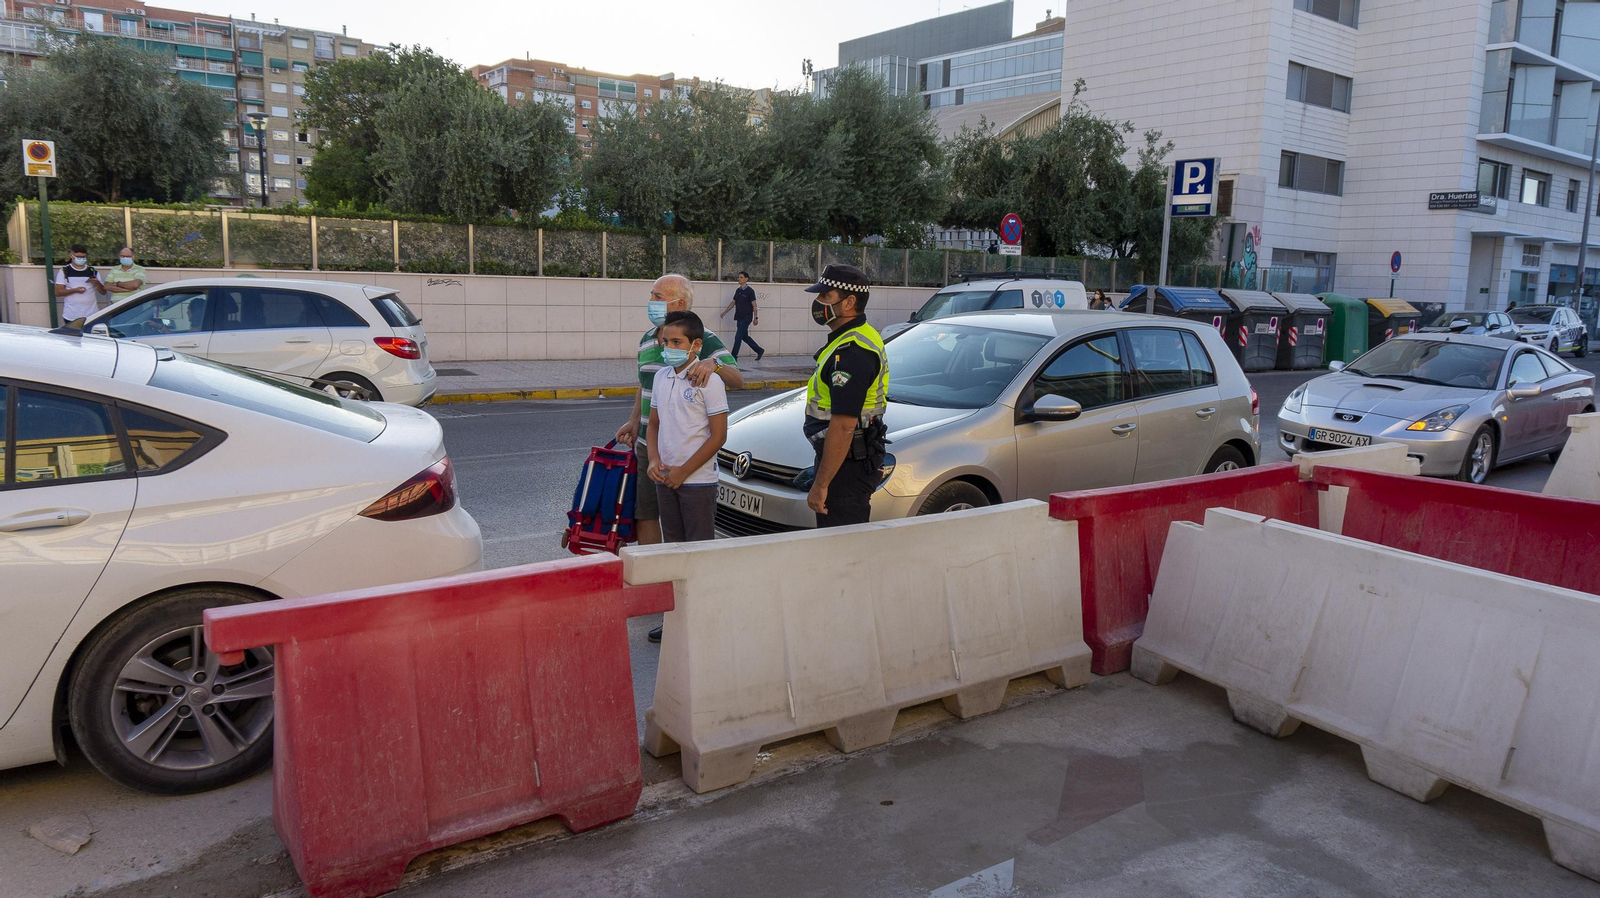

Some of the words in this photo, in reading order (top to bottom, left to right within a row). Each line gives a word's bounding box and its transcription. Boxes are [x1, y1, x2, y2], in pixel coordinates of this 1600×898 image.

[1181, 161, 1206, 194] P
[1448, 192, 1477, 200] Huertas
[1315, 430, 1327, 441] GR
[1329, 432, 1353, 445] 9024
[1355, 436, 1369, 446] AX
[740, 493, 761, 514] GVM
